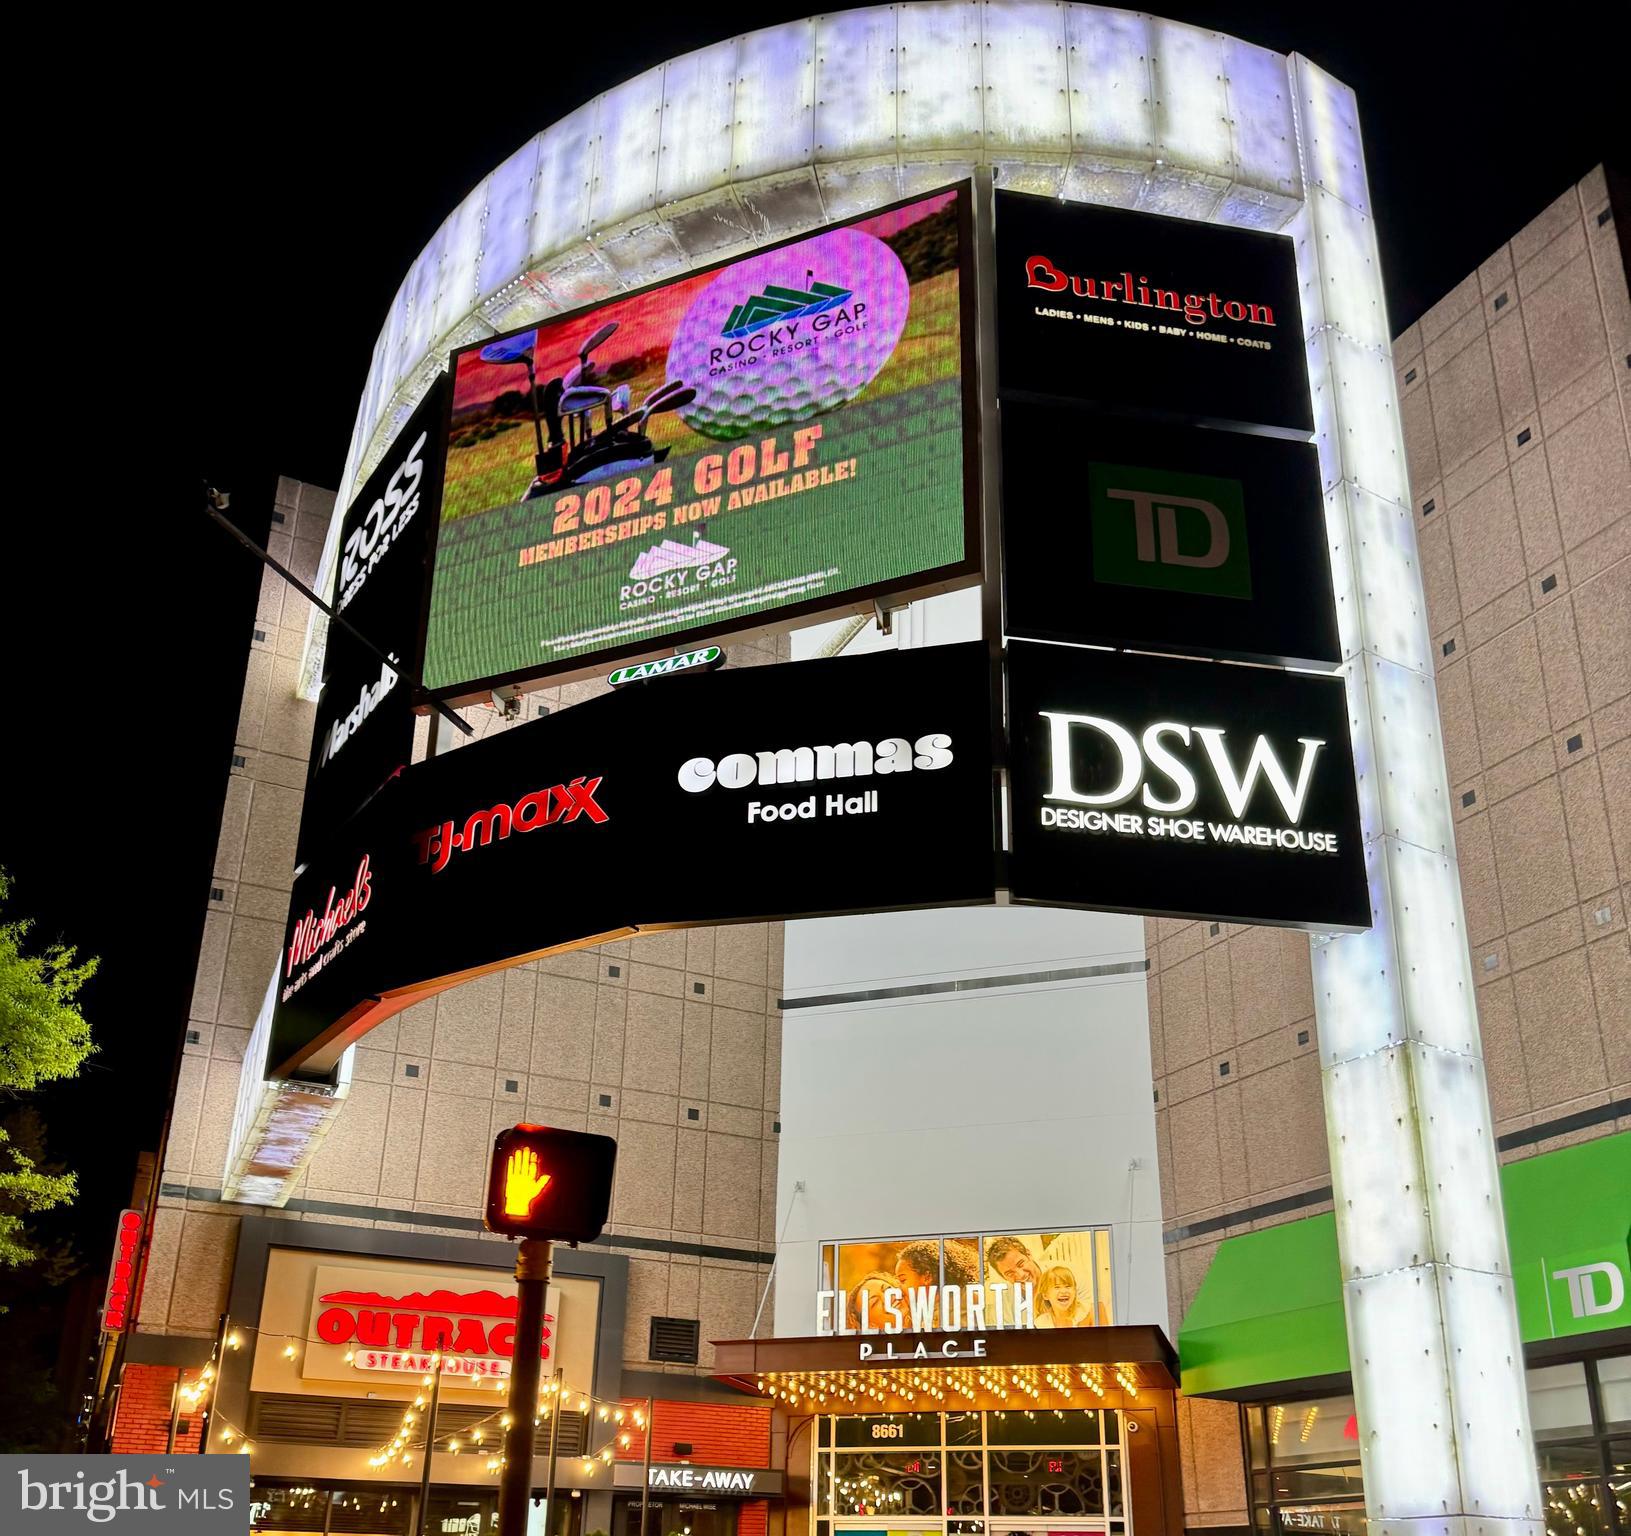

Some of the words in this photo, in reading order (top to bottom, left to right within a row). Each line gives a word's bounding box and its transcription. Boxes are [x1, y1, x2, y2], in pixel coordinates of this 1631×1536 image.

[1025, 255, 1277, 327] Burlington
[709, 322, 799, 366] ROCKY
[812, 302, 866, 332] GAP
[709, 356, 757, 377] CASINO
[772, 336, 819, 357] RESORT
[834, 321, 869, 338] GOLF
[1035, 306, 1074, 320] LADIES
[1083, 313, 1114, 326] MENS
[1124, 319, 1149, 332] KIDS
[1159, 325, 1187, 337] BABY
[1196, 331, 1228, 344] HOME
[1236, 337, 1272, 351] COATS
[553, 467, 673, 535] 2024
[693, 424, 823, 496] GOLF
[340, 430, 428, 593] ROSS
[518, 511, 667, 568] MEMBERSHIPS
[673, 496, 722, 527] NOW
[727, 458, 857, 511] AVAILABLE!
[1107, 487, 1231, 569] TD
[620, 569, 688, 601] ROCKY
[696, 557, 738, 581] GAP
[616, 650, 710, 682] LAMAR
[678, 733, 954, 793] commas
[1038, 710, 1327, 824] DSW
[748, 795, 816, 824] Food
[825, 790, 878, 817] Hall
[1040, 806, 1145, 835] DESIGNER
[1147, 816, 1206, 841] SHOE
[1208, 822, 1338, 853] WAREHOUSE
[816, 1281, 1035, 1337] ELLSWORTH
[1552, 1261, 1624, 1319] TD
[860, 1339, 987, 1361] PLACE
[872, 1423, 904, 1439] 8661
[648, 1468, 755, 1490] TAKE-AWAY
